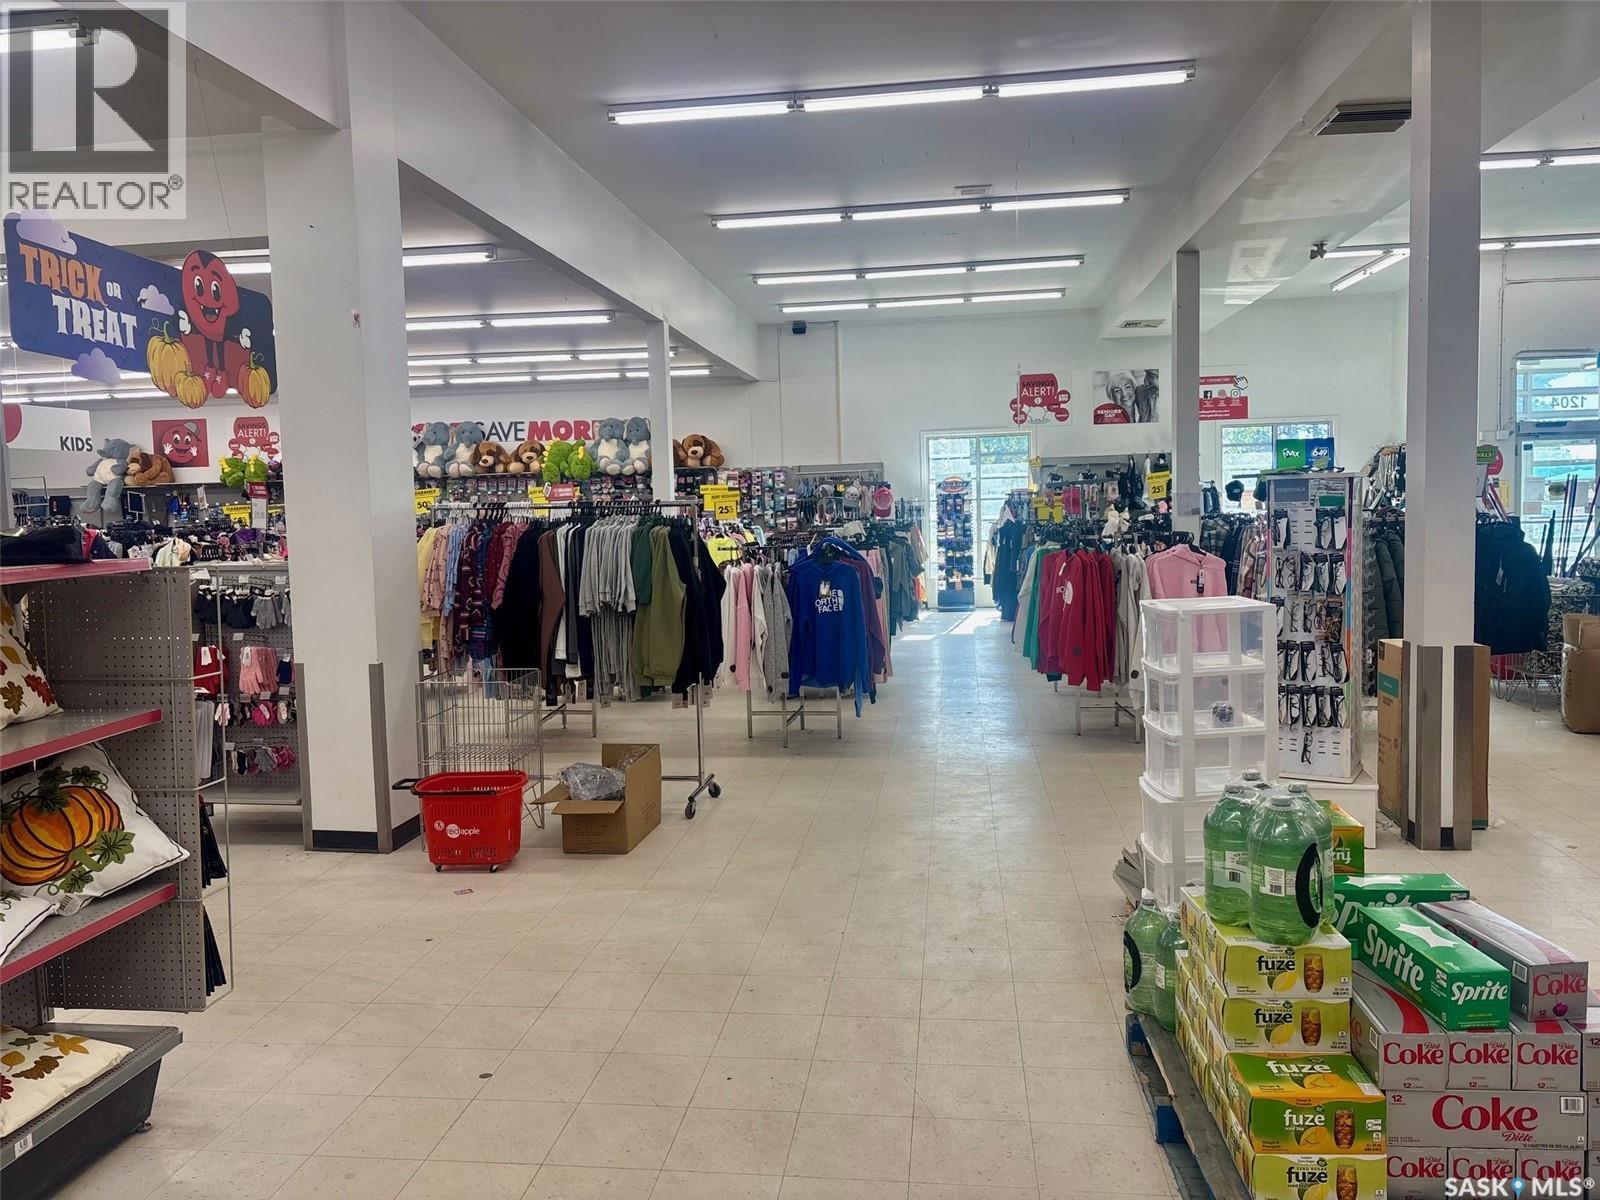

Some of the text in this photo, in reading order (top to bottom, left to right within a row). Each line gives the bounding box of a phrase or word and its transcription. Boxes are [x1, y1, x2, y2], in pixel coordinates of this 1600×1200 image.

[19, 242, 122, 306] TRICK OR
[51, 294, 137, 350] TREAT
[1021, 387, 1055, 396] ALERT!
[237, 429, 266, 438] ALERT!
[60, 436, 93, 452] KIDS
[818, 604, 838, 614] FACE
[1256, 956, 1296, 972] fuze
[1364, 923, 1424, 992] Sprite
[1451, 980, 1508, 1006] Sprite
[1534, 974, 1587, 996] Coke
[1254, 1008, 1292, 1024] fuze
[1383, 1042, 1444, 1065] Coke
[1424, 1042, 1440, 1050] Diet
[1449, 1042, 1510, 1064] Coke
[1490, 1041, 1506, 1050] Diet
[1517, 1042, 1578, 1066] Coke
[1558, 1042, 1575, 1050] Diet
[1265, 1060, 1332, 1074] fuze
[1284, 1109, 1325, 1126] fuze
[1431, 1094, 1538, 1132] Coke
[1502, 1132, 1534, 1142] Diète
[1386, 1156, 1444, 1178] Coke
[1425, 1156, 1442, 1164] Diet
[1286, 1166, 1328, 1184] fuze
[1452, 1158, 1514, 1180] Coke
[1521, 1159, 1582, 1182] Coke
